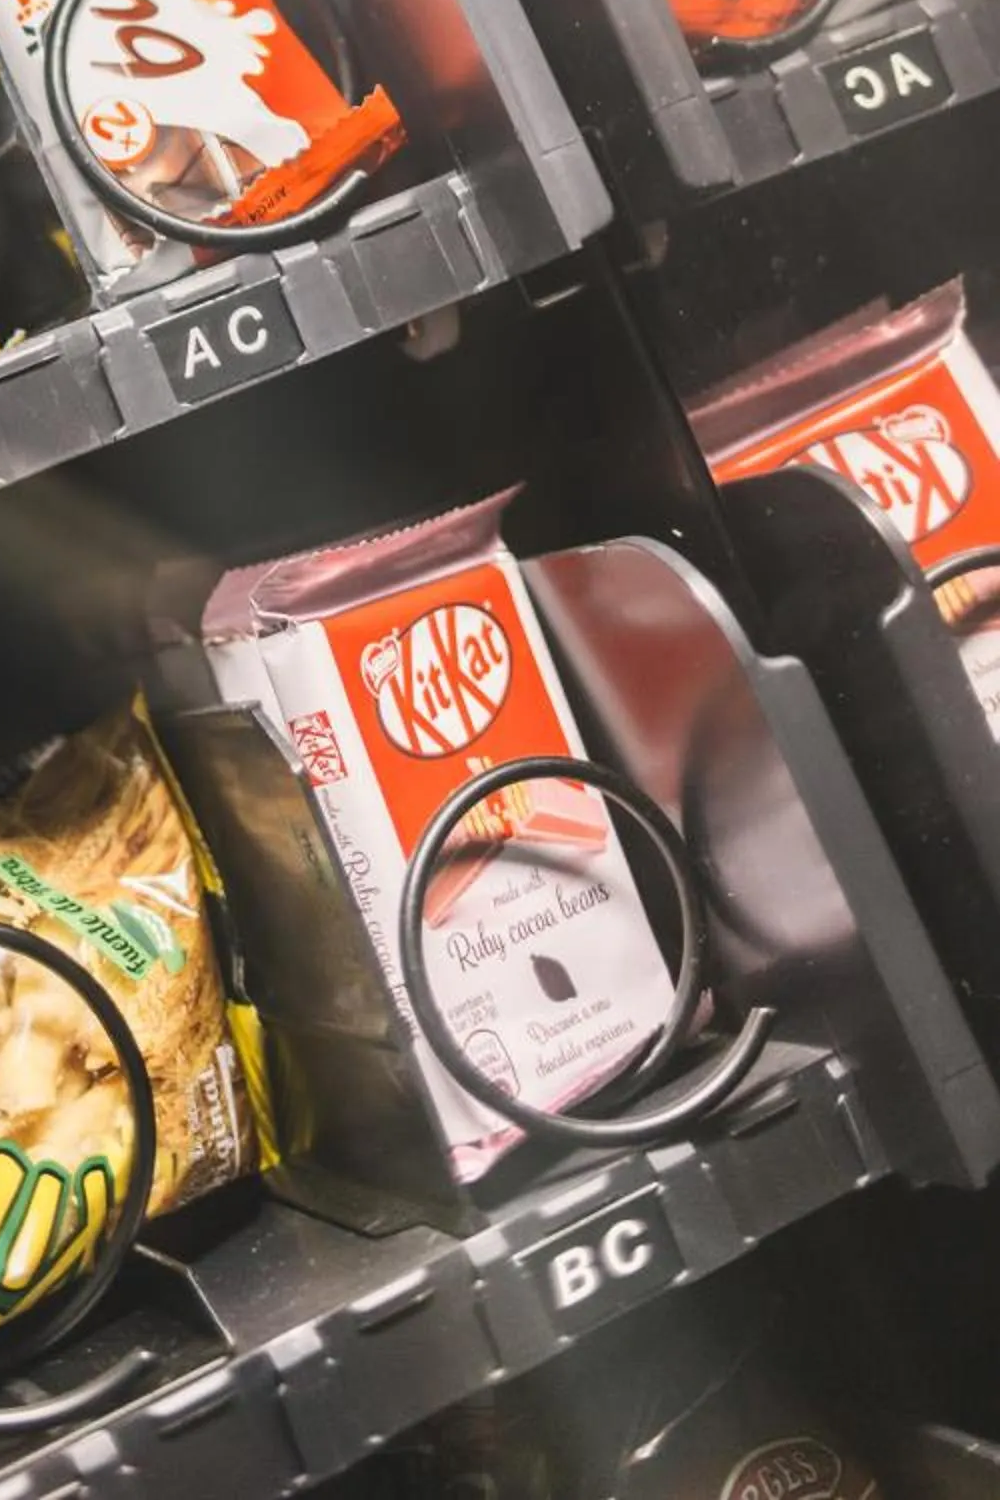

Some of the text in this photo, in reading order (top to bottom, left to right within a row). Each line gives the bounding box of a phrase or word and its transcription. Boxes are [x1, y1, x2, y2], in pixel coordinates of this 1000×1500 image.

[185, 307, 269, 379] AC
[383, 604, 510, 758] KitKat
[344, 850, 381, 912] Ruby
[446, 881, 611, 973] Ruby cocoa beans
[551, 1218, 652, 1309] BC
[738, 1450, 820, 1500] RGES
